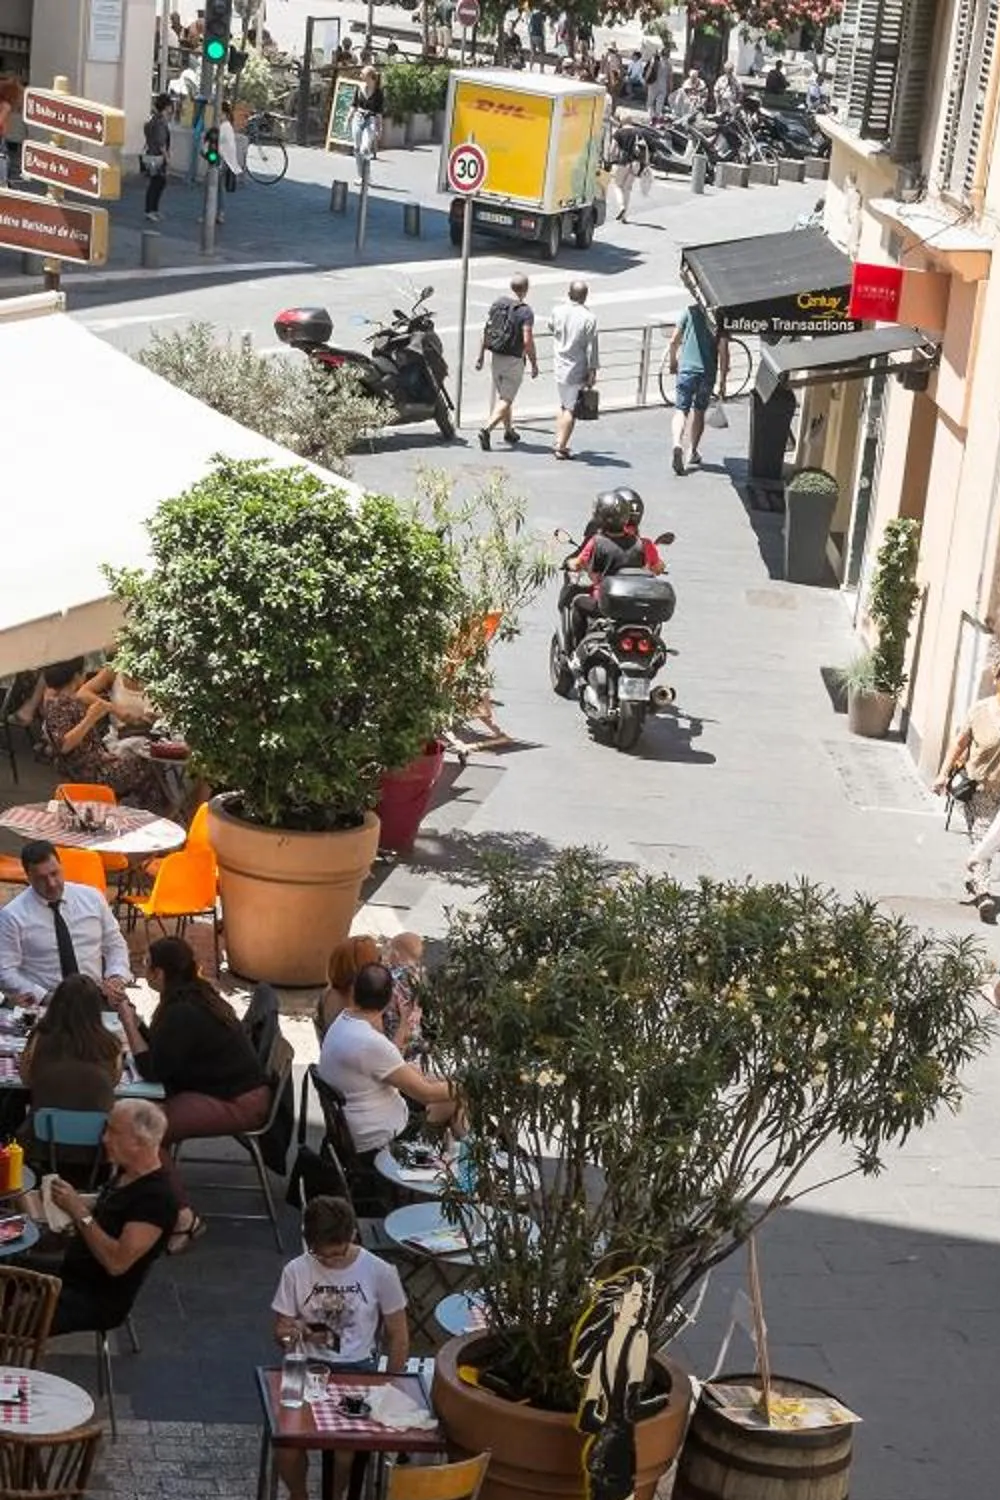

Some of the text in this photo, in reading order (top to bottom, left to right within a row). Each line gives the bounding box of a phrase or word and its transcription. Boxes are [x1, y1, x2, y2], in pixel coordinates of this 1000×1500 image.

[474, 99, 529, 117] DHL
[456, 159, 478, 179] 30
[797, 293, 841, 309] Century
[724, 317, 855, 331] Lafage Transactions
